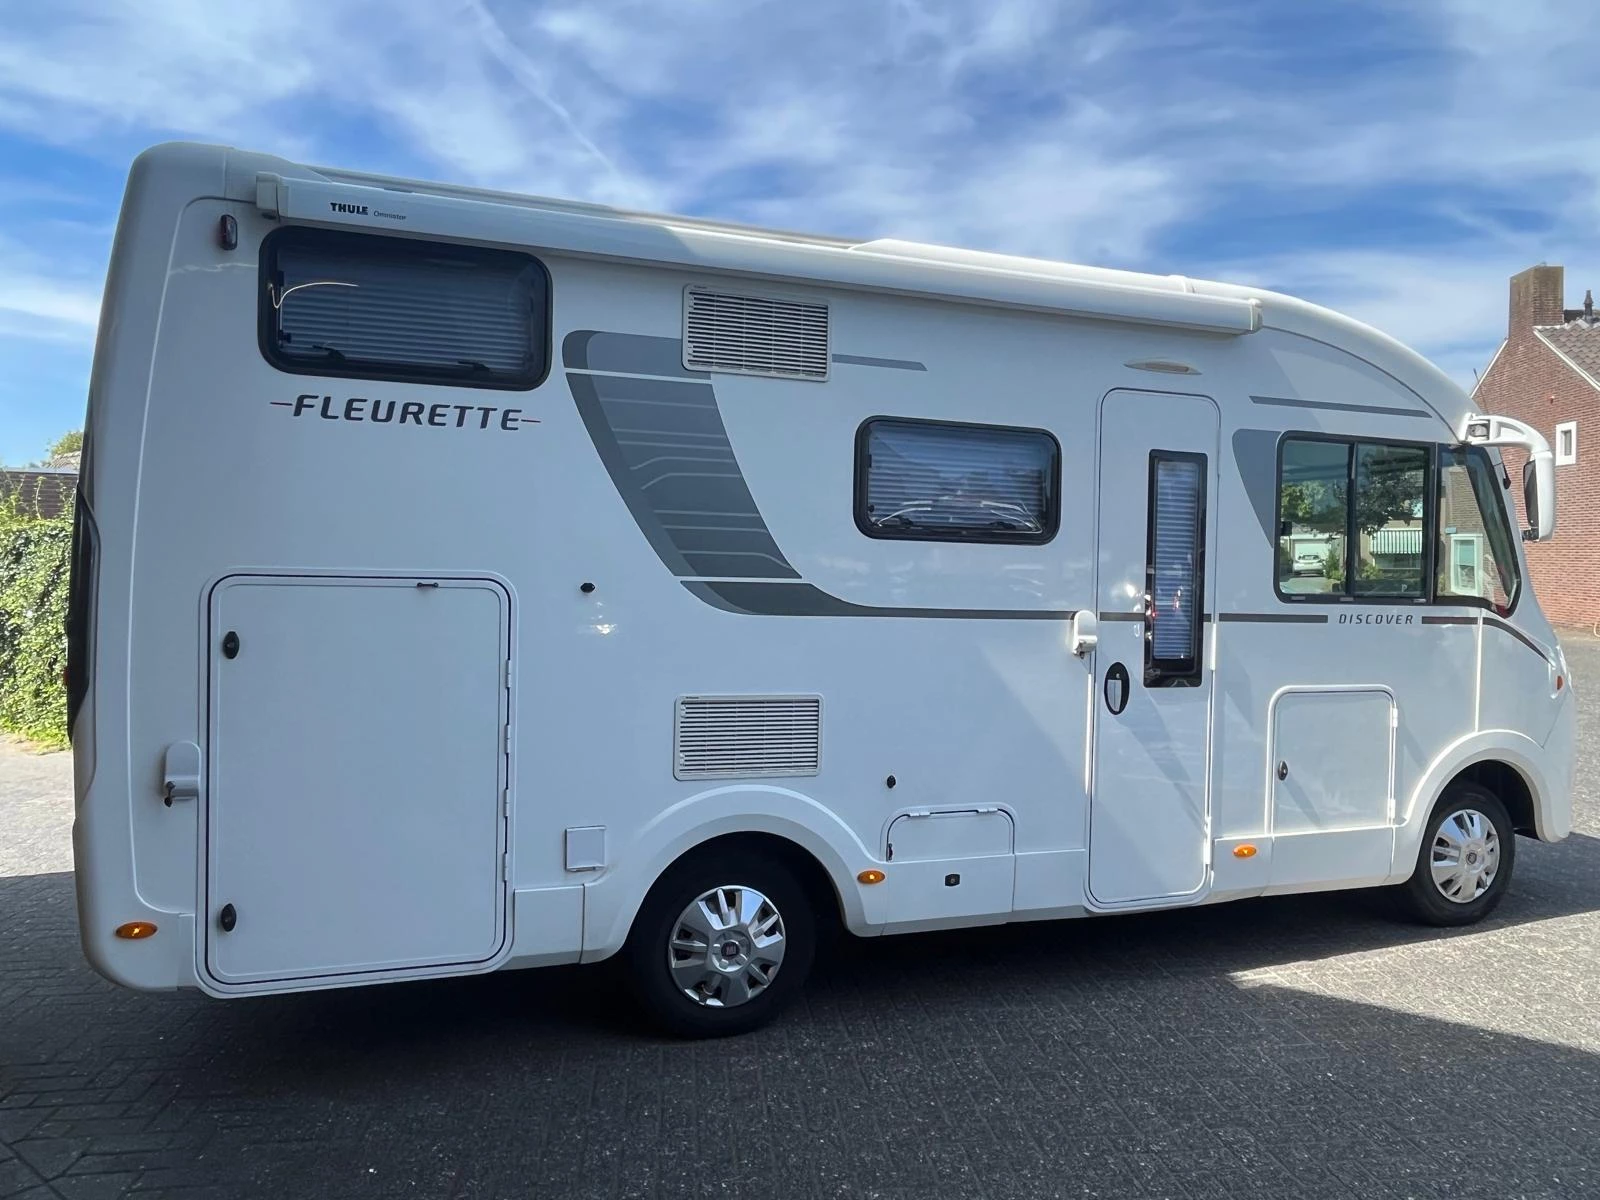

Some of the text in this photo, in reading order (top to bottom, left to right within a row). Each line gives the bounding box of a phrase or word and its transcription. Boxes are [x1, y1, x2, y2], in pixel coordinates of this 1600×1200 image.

[330, 202, 368, 216] THULE
[293, 394, 523, 431] FLEURETTE
[1338, 613, 1414, 625] DISCOVER
